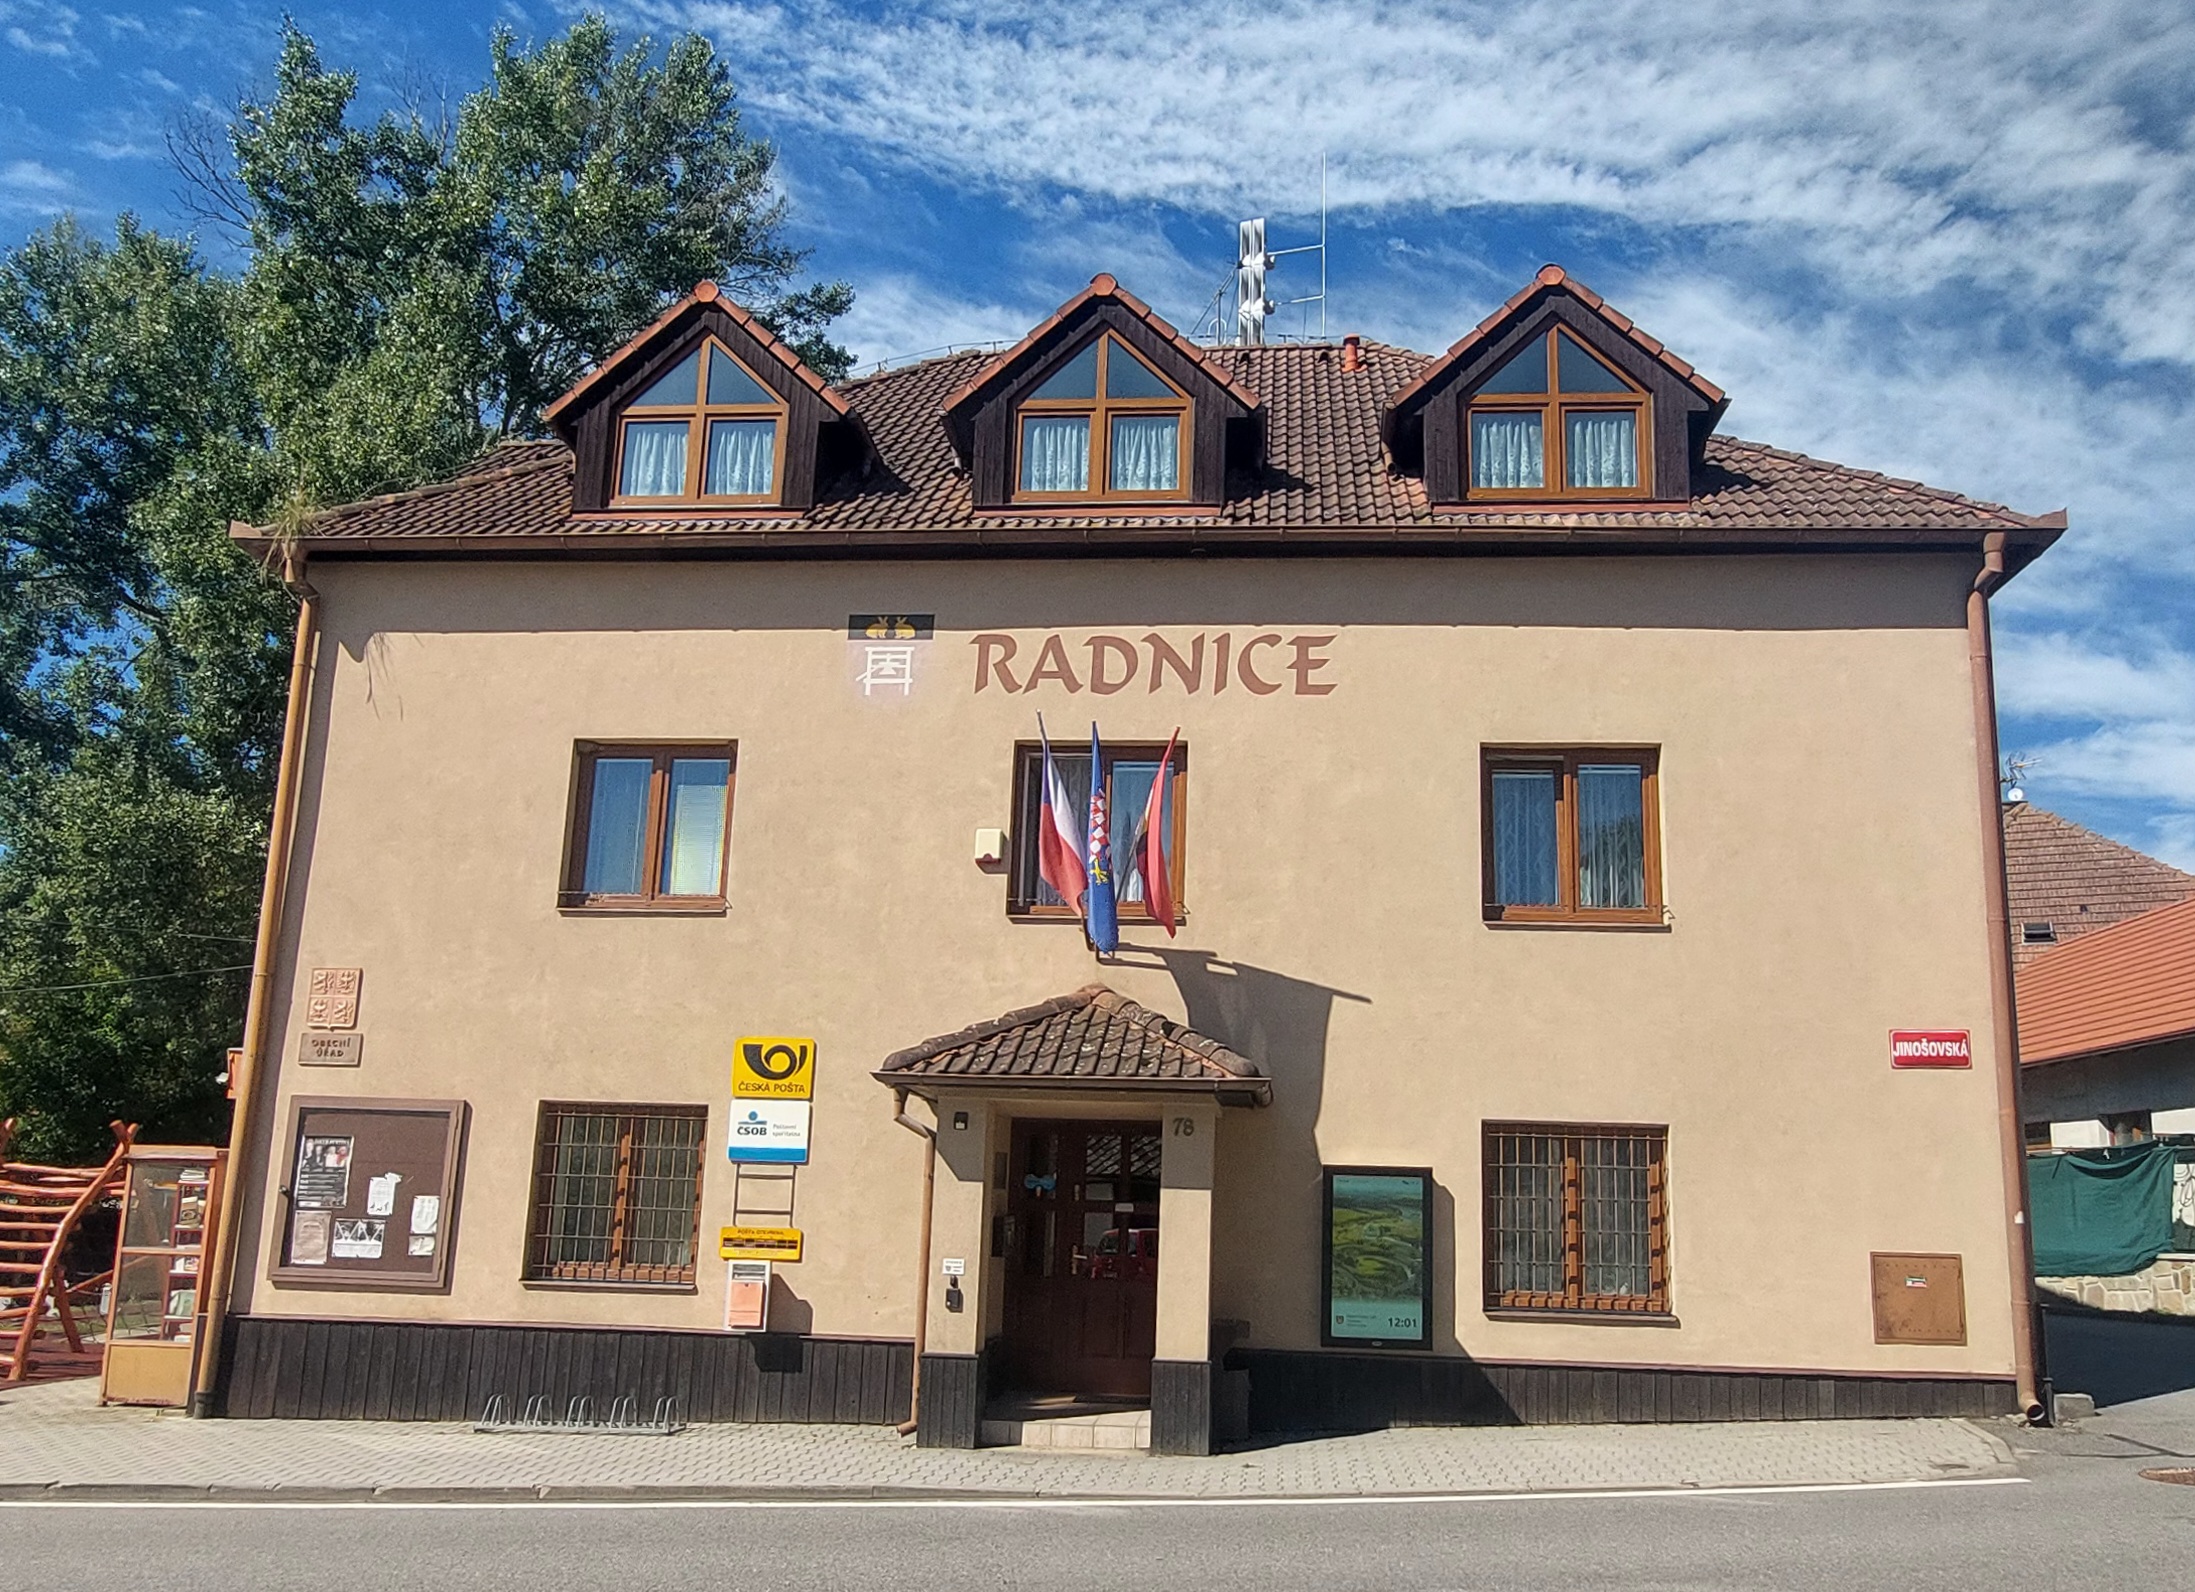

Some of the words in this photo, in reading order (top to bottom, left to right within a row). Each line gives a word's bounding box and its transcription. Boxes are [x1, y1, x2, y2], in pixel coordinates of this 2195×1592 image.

[968, 632, 1339, 696] RADNICE
[1893, 1037, 1969, 1057] JINOŠOVSKÁ
[738, 1081, 770, 1093] ČESKÁ
[773, 1082, 805, 1094] POŠTA
[737, 1125, 767, 1136] ČSOB
[1172, 1117, 1194, 1137] 78
[1388, 1316, 1417, 1328] 12:01
